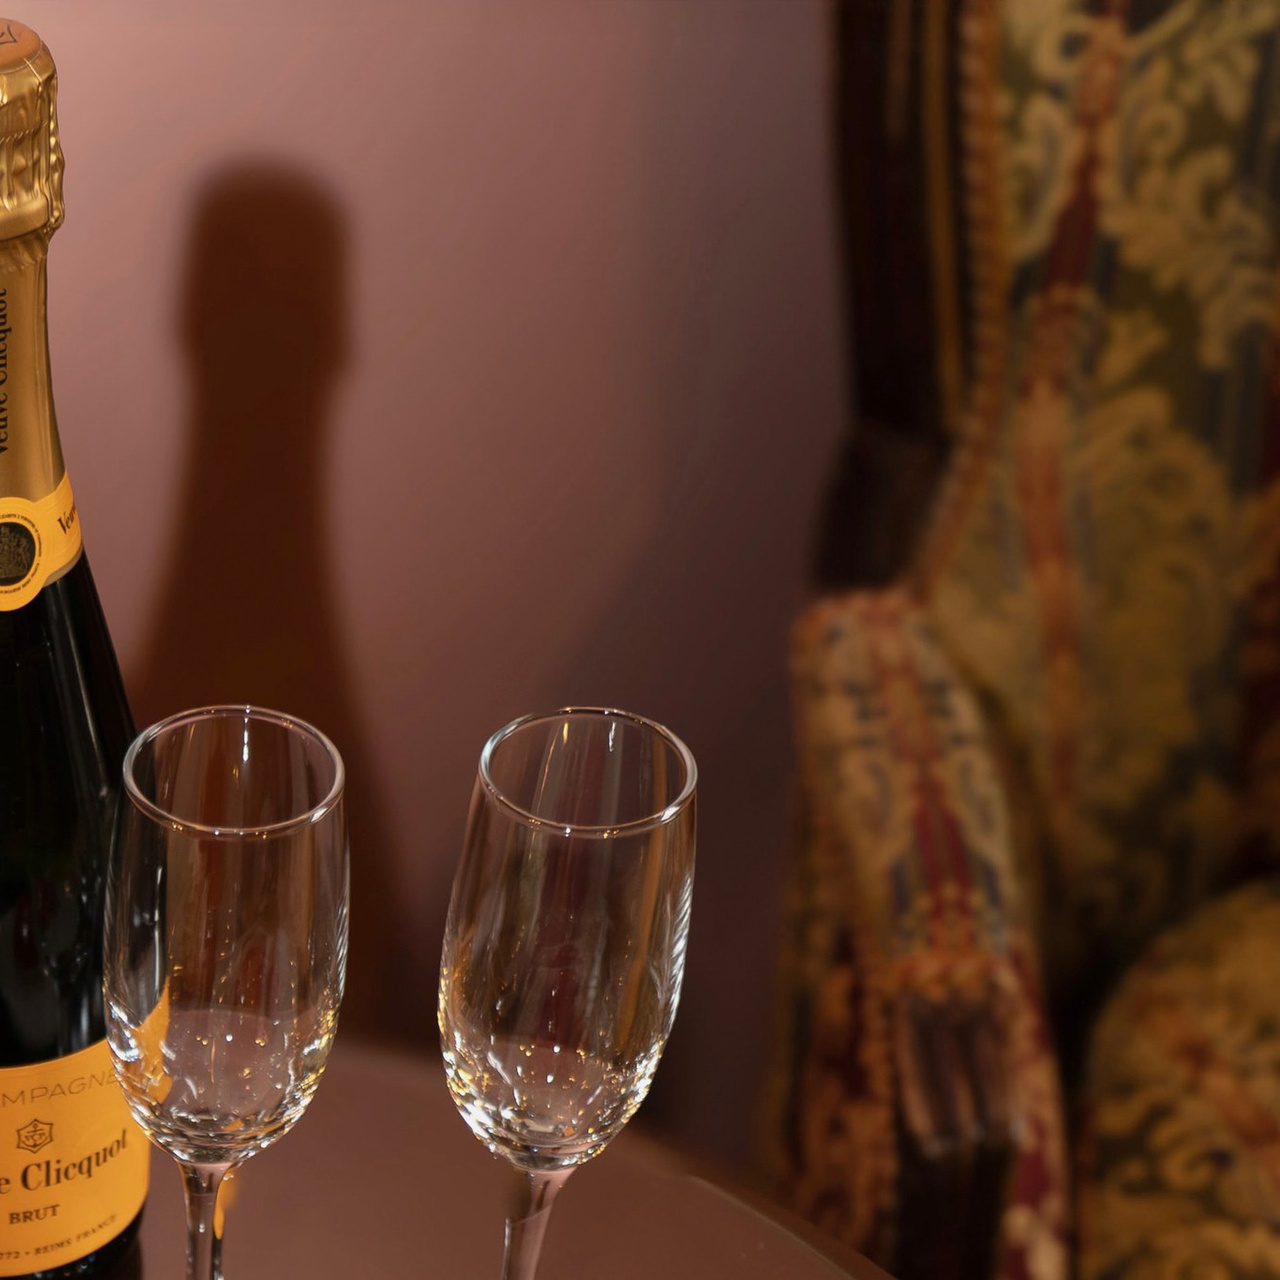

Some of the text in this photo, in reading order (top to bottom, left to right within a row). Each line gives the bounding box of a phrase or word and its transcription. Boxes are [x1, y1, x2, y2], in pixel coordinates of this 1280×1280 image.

[20, 1128, 128, 1192] Clicquot
[8, 1204, 60, 1225] BRUT
[75, 1213, 118, 1243] FRANCE
